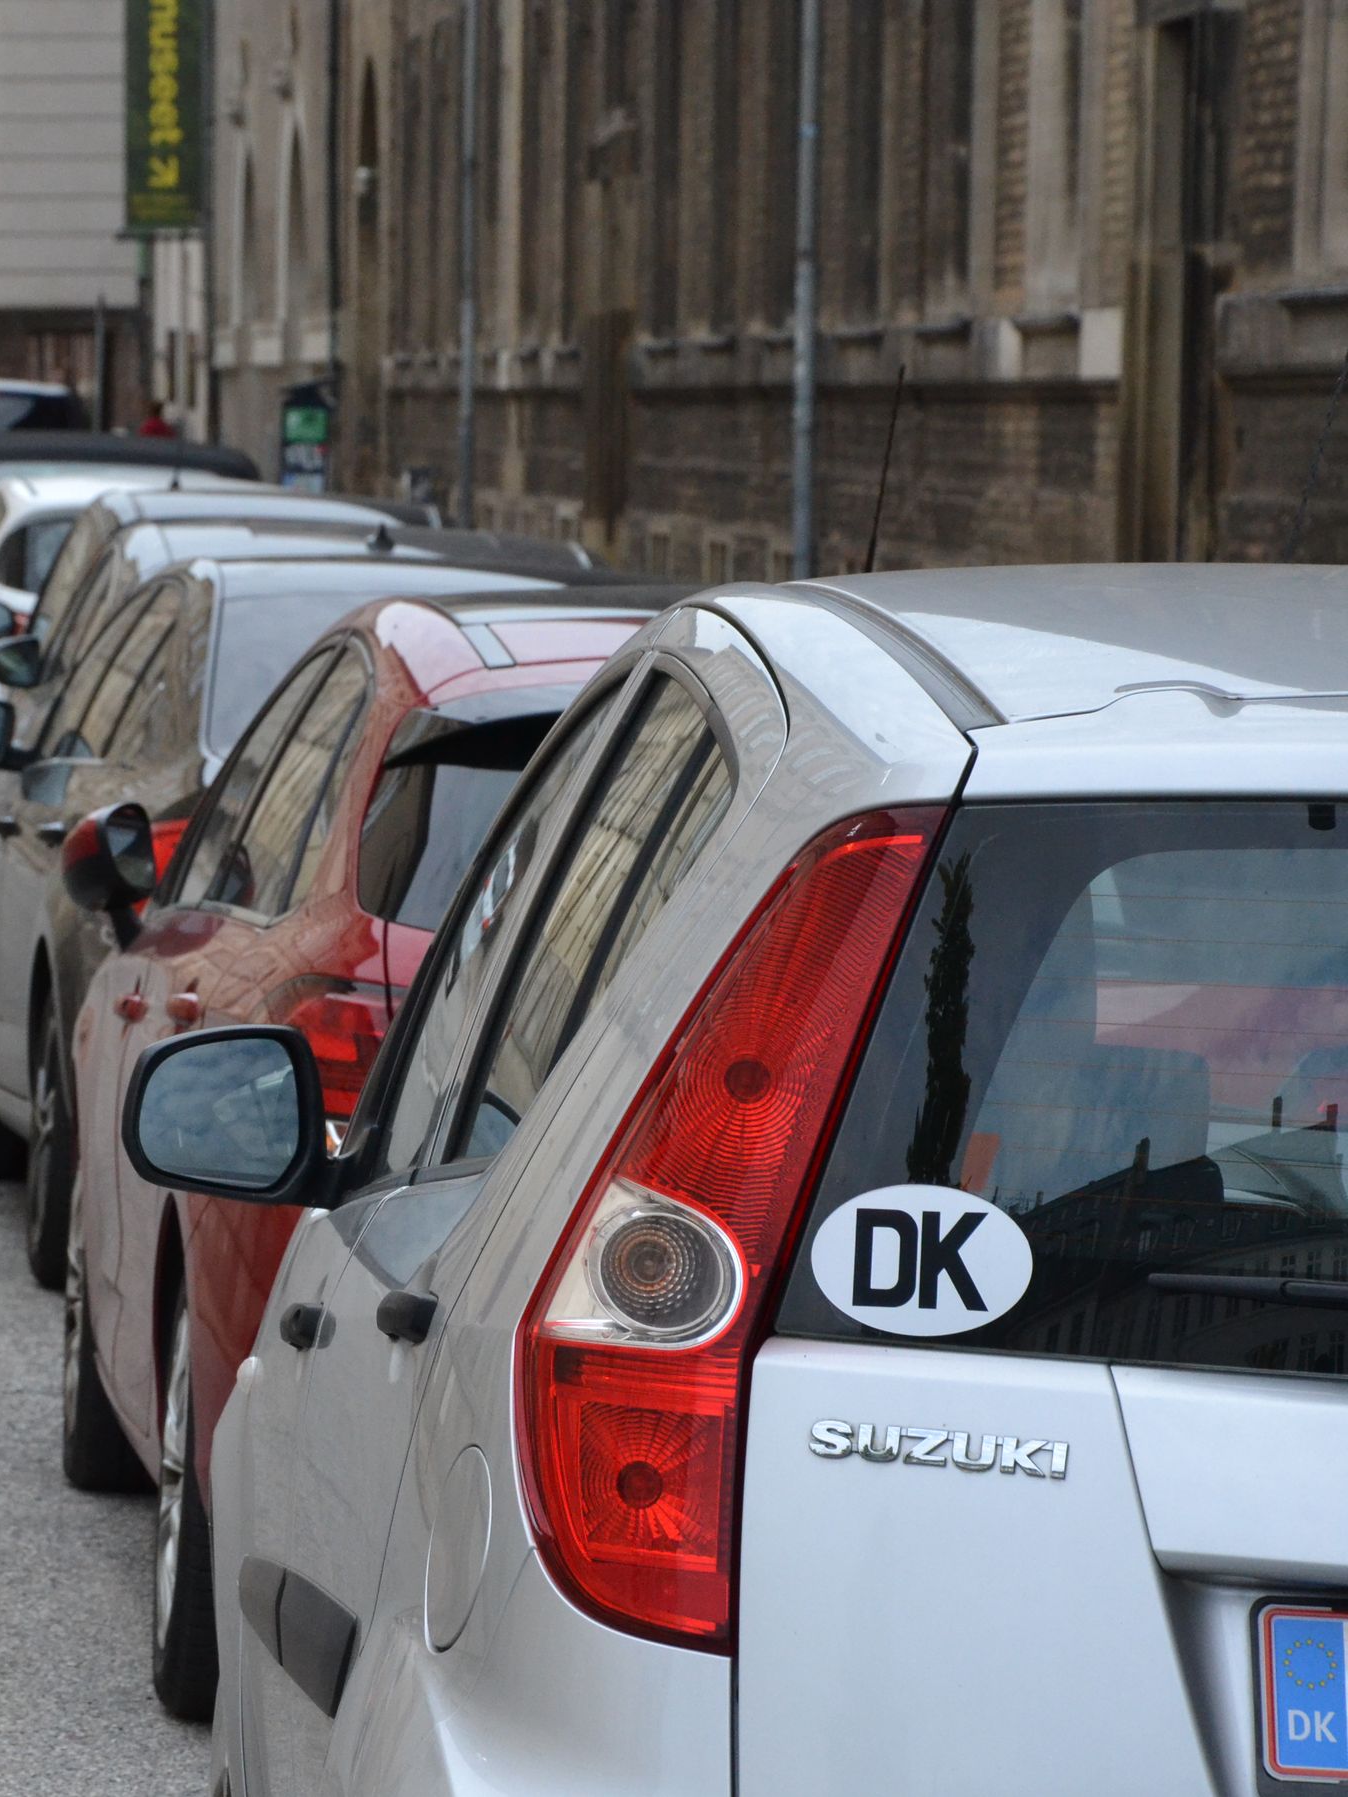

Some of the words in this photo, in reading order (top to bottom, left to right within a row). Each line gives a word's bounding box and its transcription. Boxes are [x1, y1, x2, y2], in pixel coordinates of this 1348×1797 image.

[852, 1208, 989, 1312] DK
[809, 1419, 1070, 1480] SUZUKI
[1288, 1709, 1338, 1743] DK
